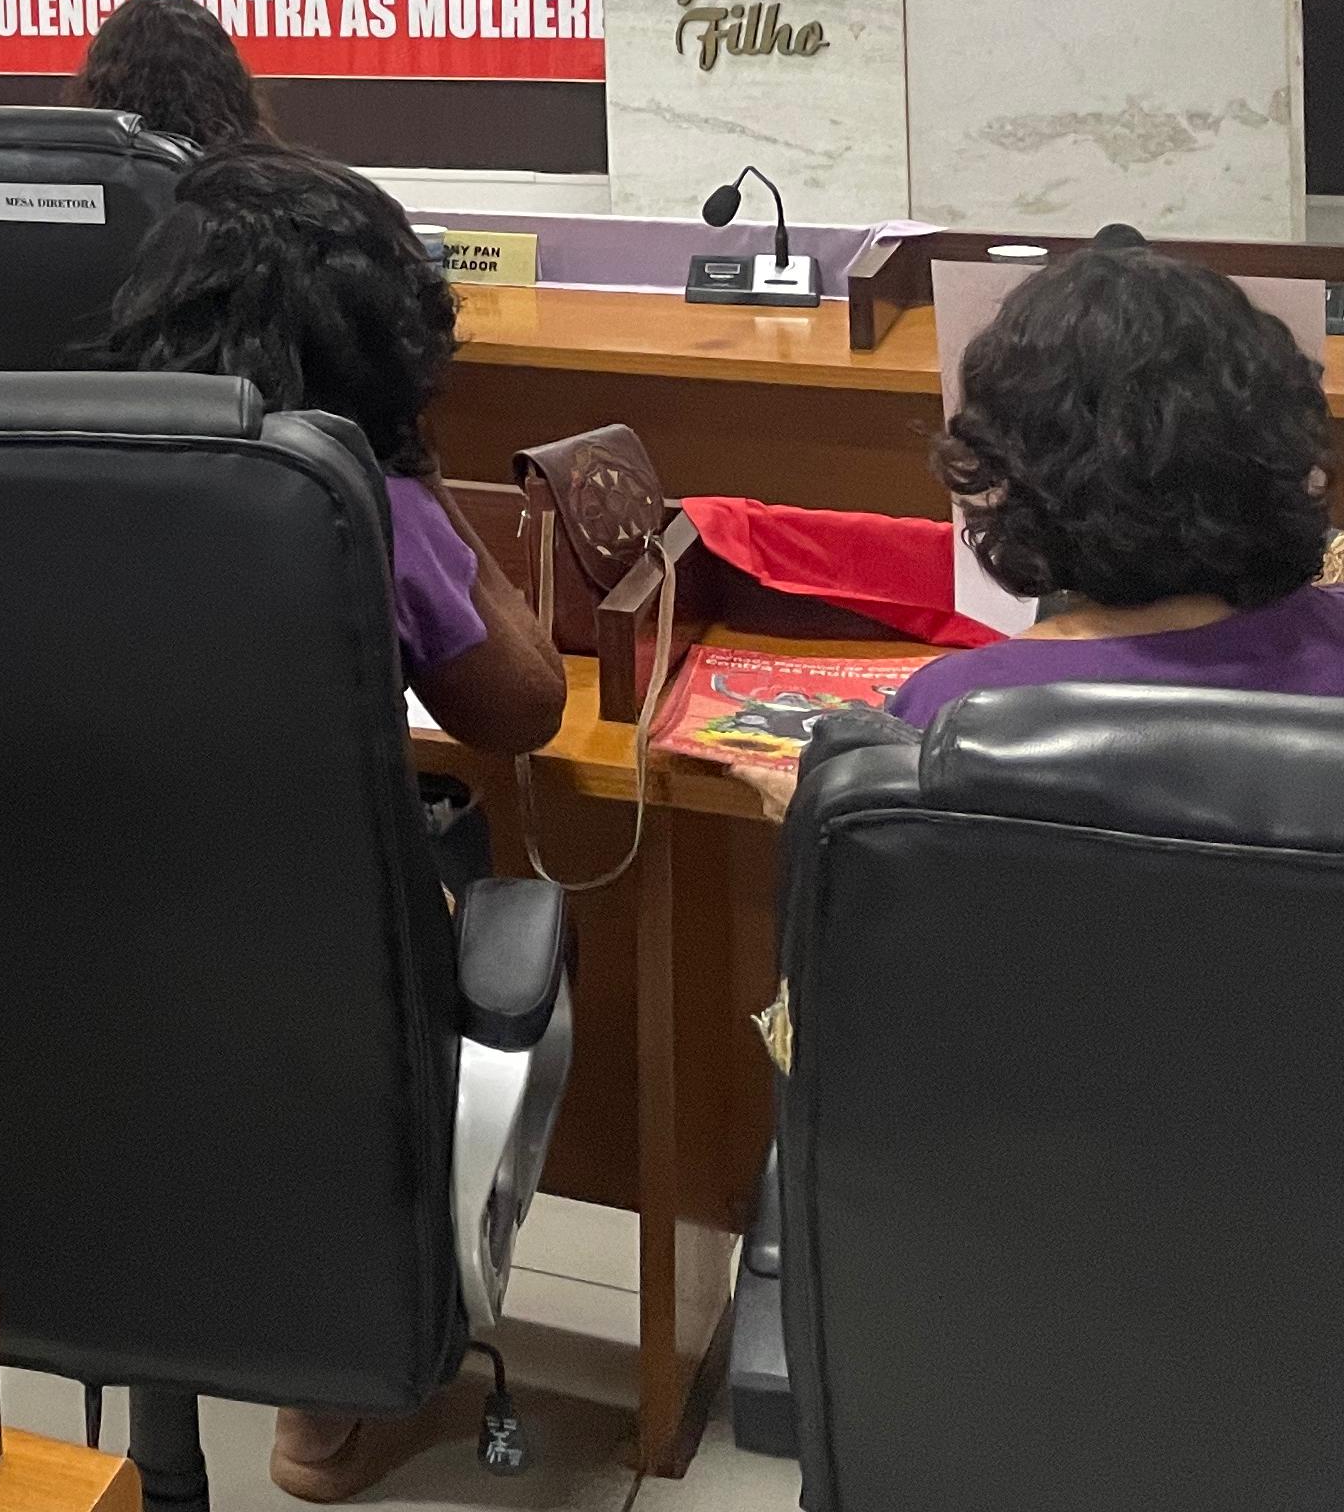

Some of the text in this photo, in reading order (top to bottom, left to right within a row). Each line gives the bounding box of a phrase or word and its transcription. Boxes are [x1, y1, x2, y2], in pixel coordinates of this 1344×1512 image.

[675, 2, 831, 71] Filho
[5, 196, 97, 209] MESA DIRETORA
[473, 246, 501, 258] PAN
[443, 258, 498, 272] READOR
[706, 658, 772, 672] Contra
